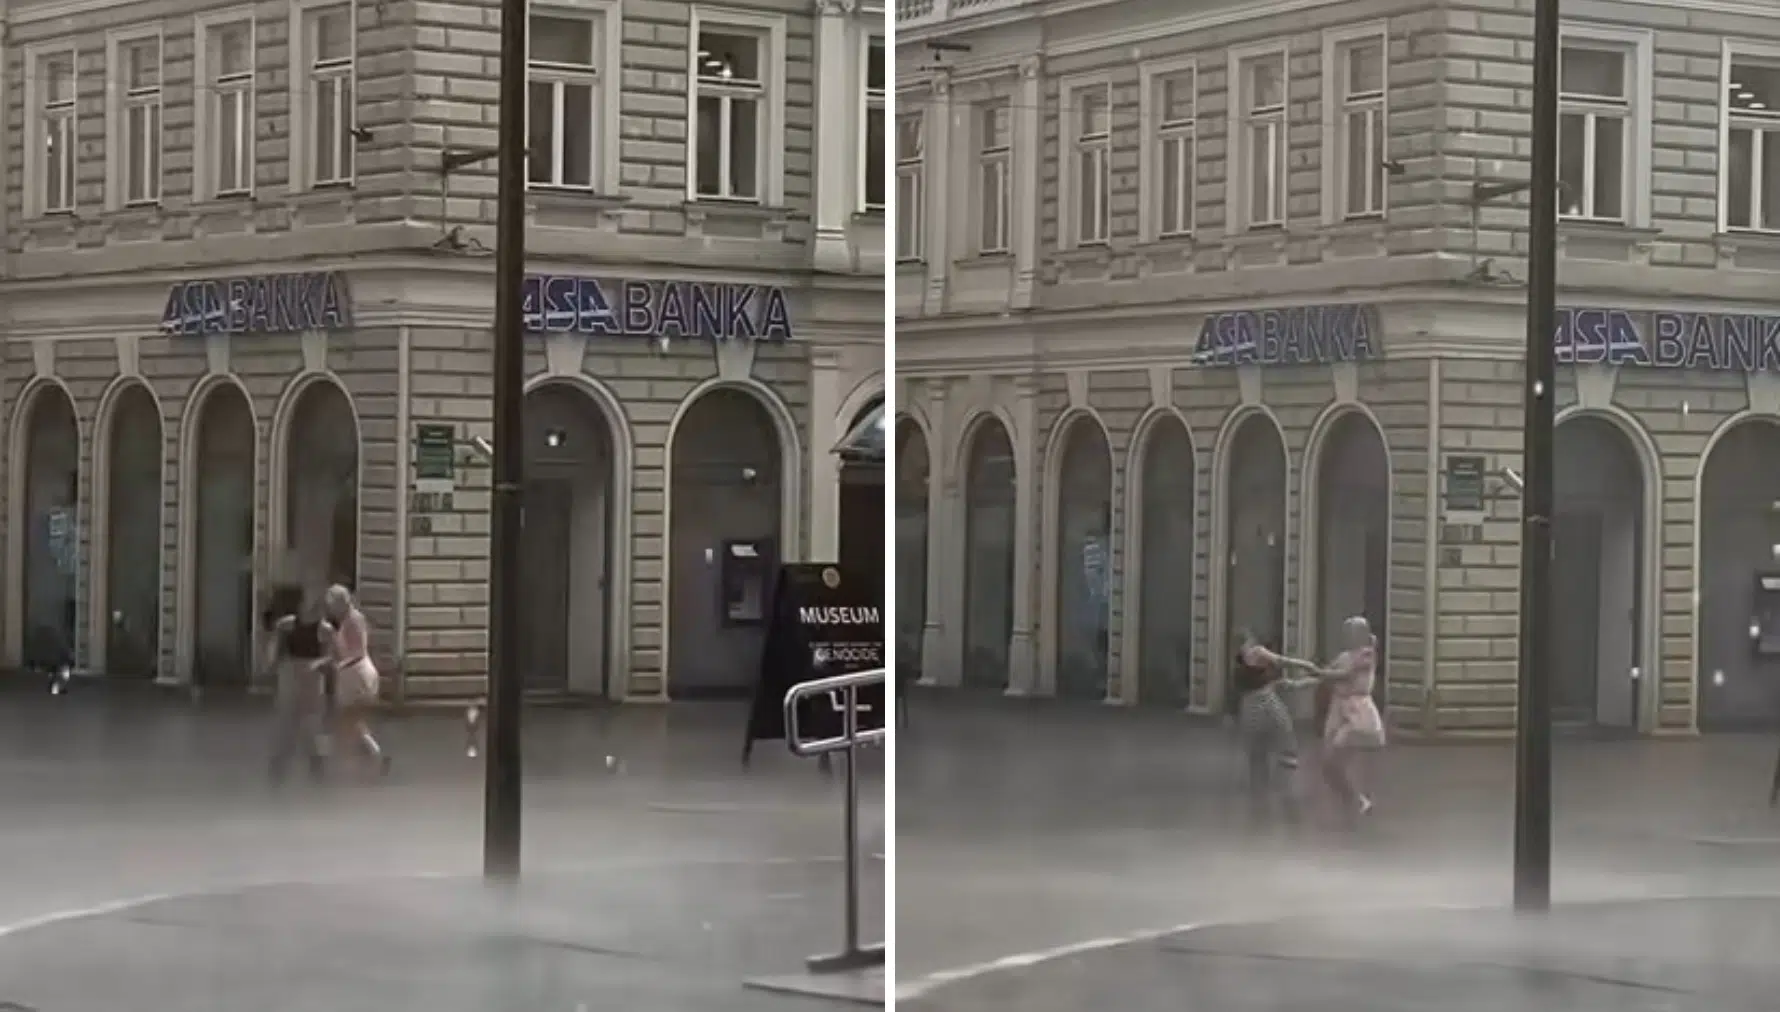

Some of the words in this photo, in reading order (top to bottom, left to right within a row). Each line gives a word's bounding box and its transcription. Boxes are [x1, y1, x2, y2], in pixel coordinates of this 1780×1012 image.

[159, 281, 228, 334] ASA
[228, 271, 347, 332] BANKA
[623, 279, 798, 340] BANKA
[1190, 311, 1260, 367] ASA
[1261, 303, 1378, 364] BANKA
[799, 606, 880, 625] MUSEUM
